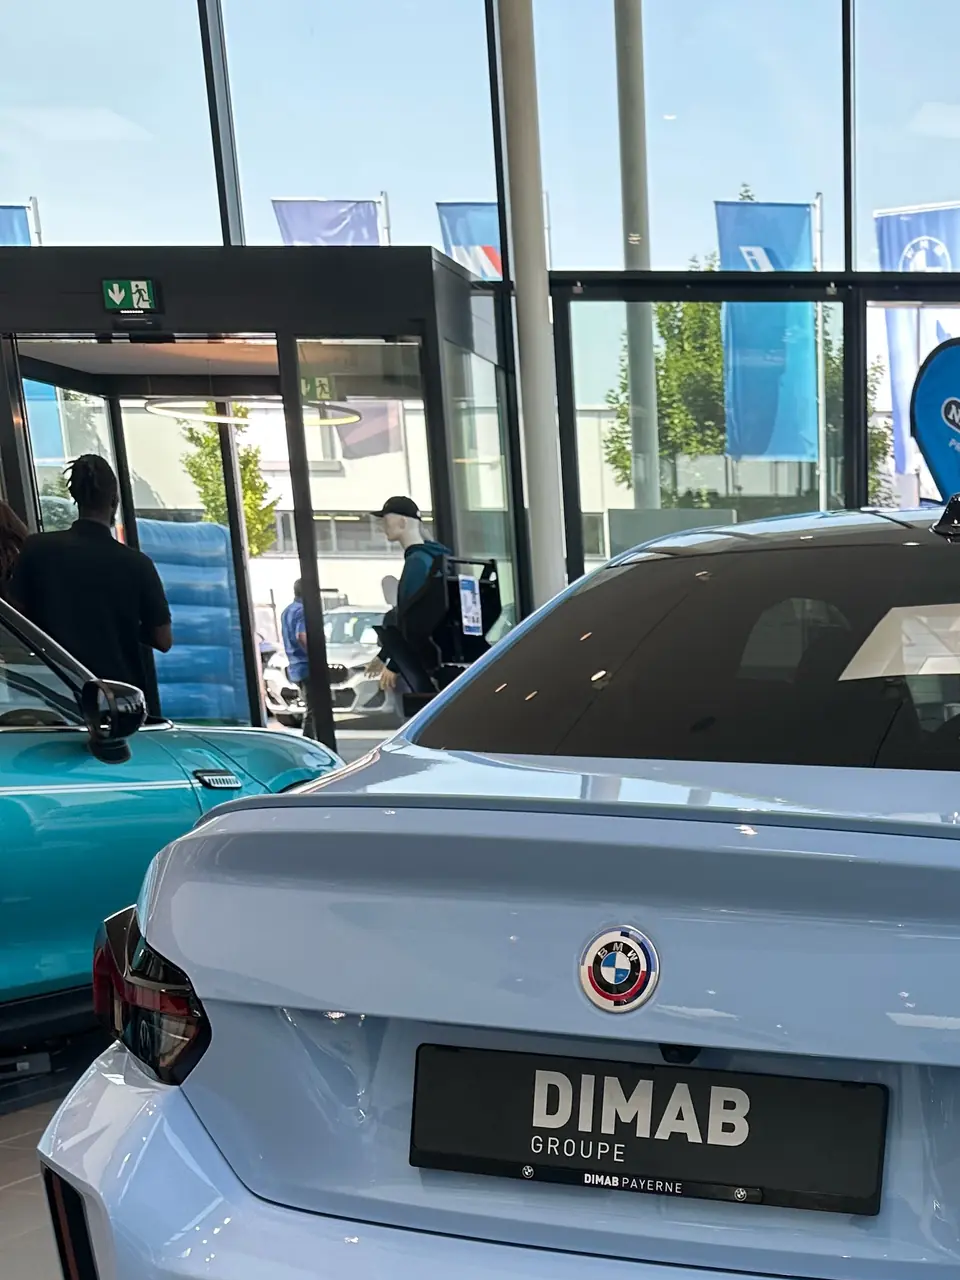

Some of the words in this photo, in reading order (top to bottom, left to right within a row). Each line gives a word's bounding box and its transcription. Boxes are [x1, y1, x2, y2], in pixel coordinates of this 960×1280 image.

[532, 1069, 751, 1147] DIMAB
[530, 1135, 626, 1163] GROUPE
[584, 1173, 619, 1187] DIMAB
[621, 1177, 683, 1194] PAYERNE
